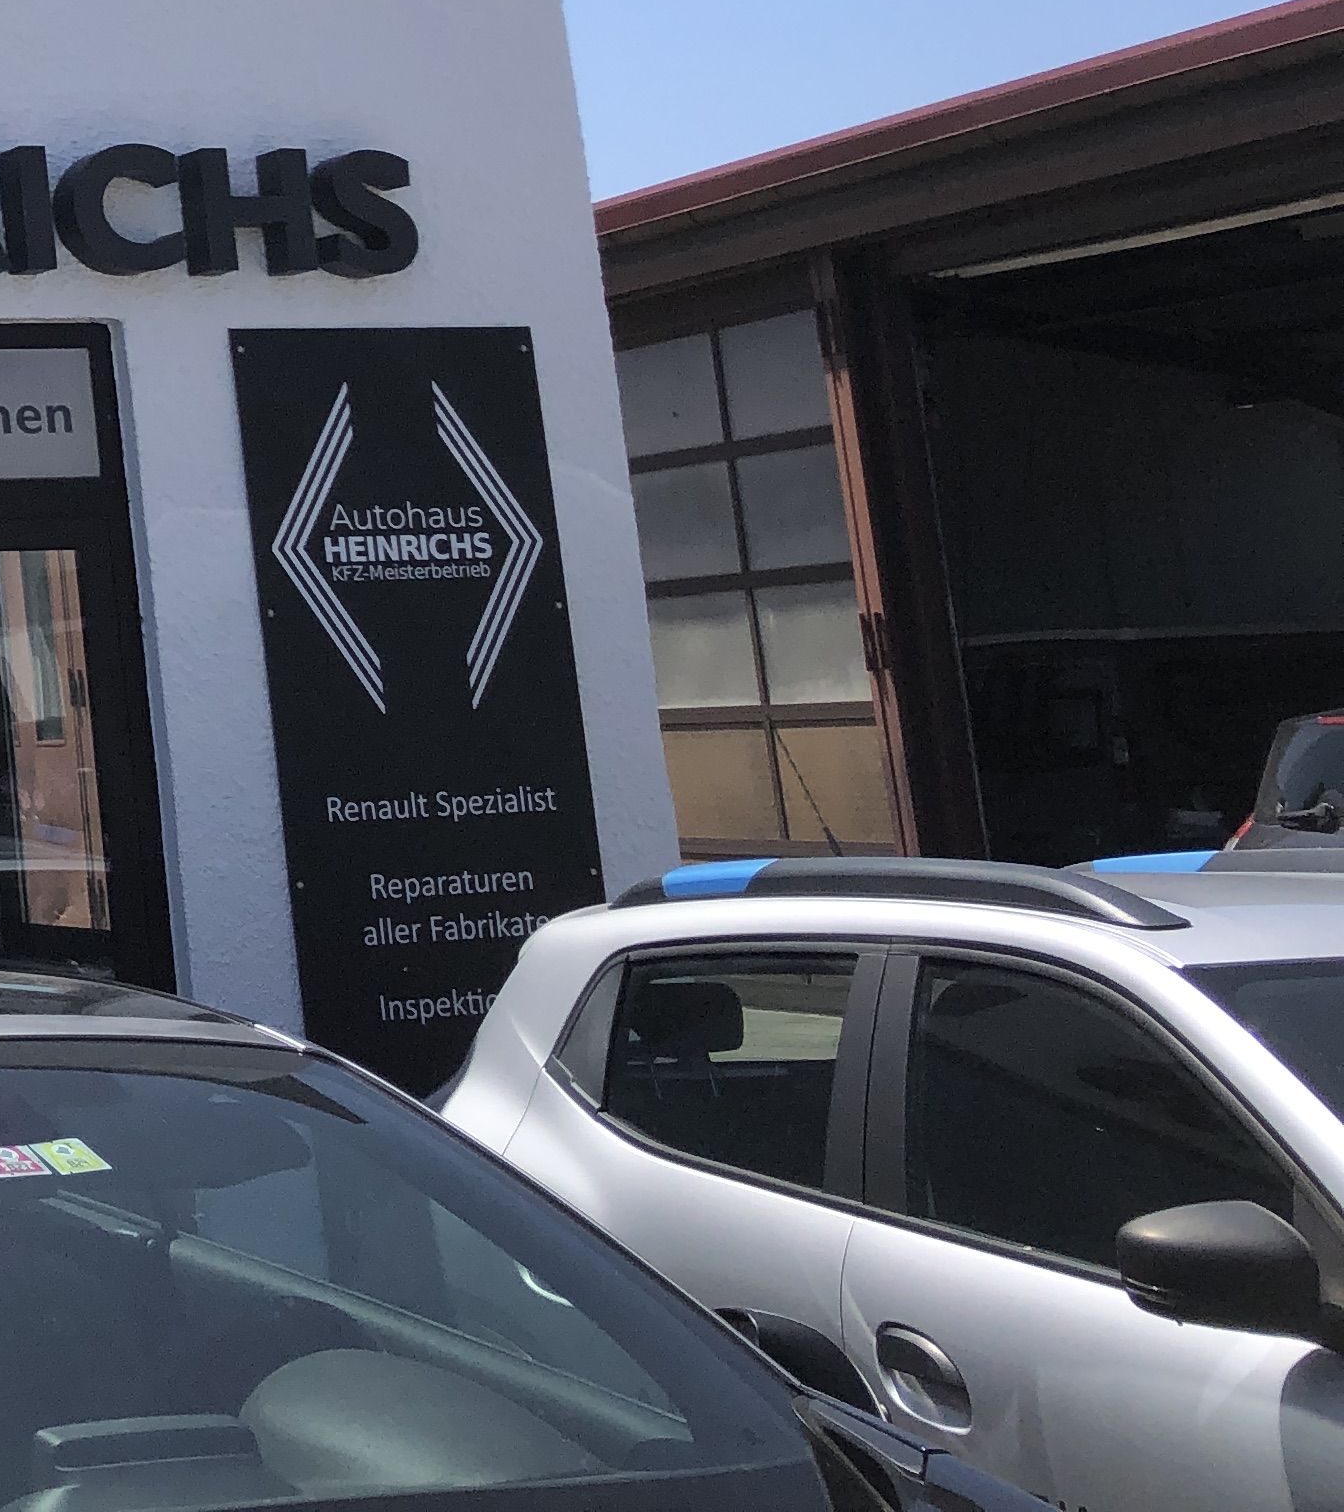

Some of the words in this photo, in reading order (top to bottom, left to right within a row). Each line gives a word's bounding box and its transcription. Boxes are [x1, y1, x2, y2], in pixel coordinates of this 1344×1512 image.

[330, 500, 483, 531] Autohaus
[324, 532, 493, 563] HEINRICHS
[332, 561, 491, 582] KFZ-Meisterbetrieb
[326, 791, 429, 823] Renault
[435, 786, 557, 822] Spezialist
[370, 870, 534, 904] Reparaturen
[364, 918, 421, 946] aller
